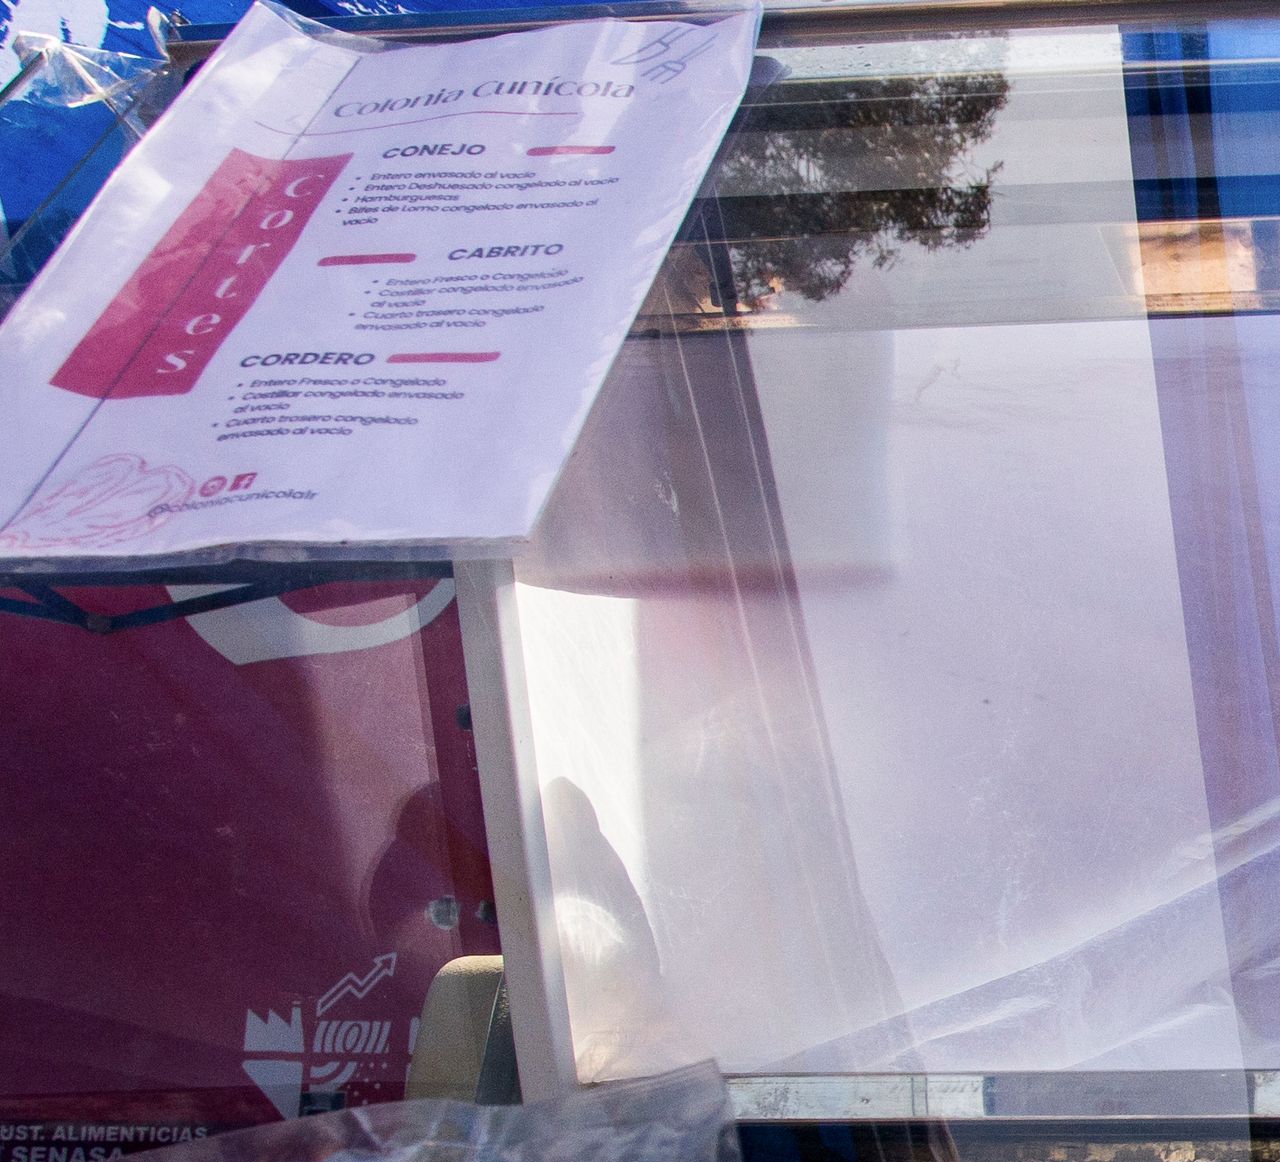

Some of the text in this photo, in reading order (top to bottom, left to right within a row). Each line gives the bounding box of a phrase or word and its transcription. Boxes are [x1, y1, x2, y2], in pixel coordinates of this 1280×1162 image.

[333, 76, 635, 119] Colonia Cunícola
[382, 143, 486, 159] CONEJO
[370, 172, 412, 181] Entero
[414, 171, 481, 180] envasado
[483, 171, 498, 180] al
[364, 183, 407, 192] Entero
[408, 182, 492, 191] Deshuesado
[494, 180, 567, 193] congelado
[568, 179, 583, 188] al
[354, 195, 461, 205] Hamburguesas
[382, 206, 399, 214] de
[401, 204, 439, 213] Lomo
[441, 202, 514, 214] congelado
[515, 200, 583, 210] envasado
[585, 198, 600, 208] al
[448, 243, 564, 261] CABRITO
[438, 283, 515, 294] congelado
[467, 304, 545, 318] congelado
[354, 322, 428, 332] envasado
[239, 352, 375, 368] CORDERO
[303, 389, 386, 401] congelado
[333, 414, 418, 426] congelado
[216, 427, 290, 441] envasado
[52, 1126, 208, 1142] ALIMENTICIAS
